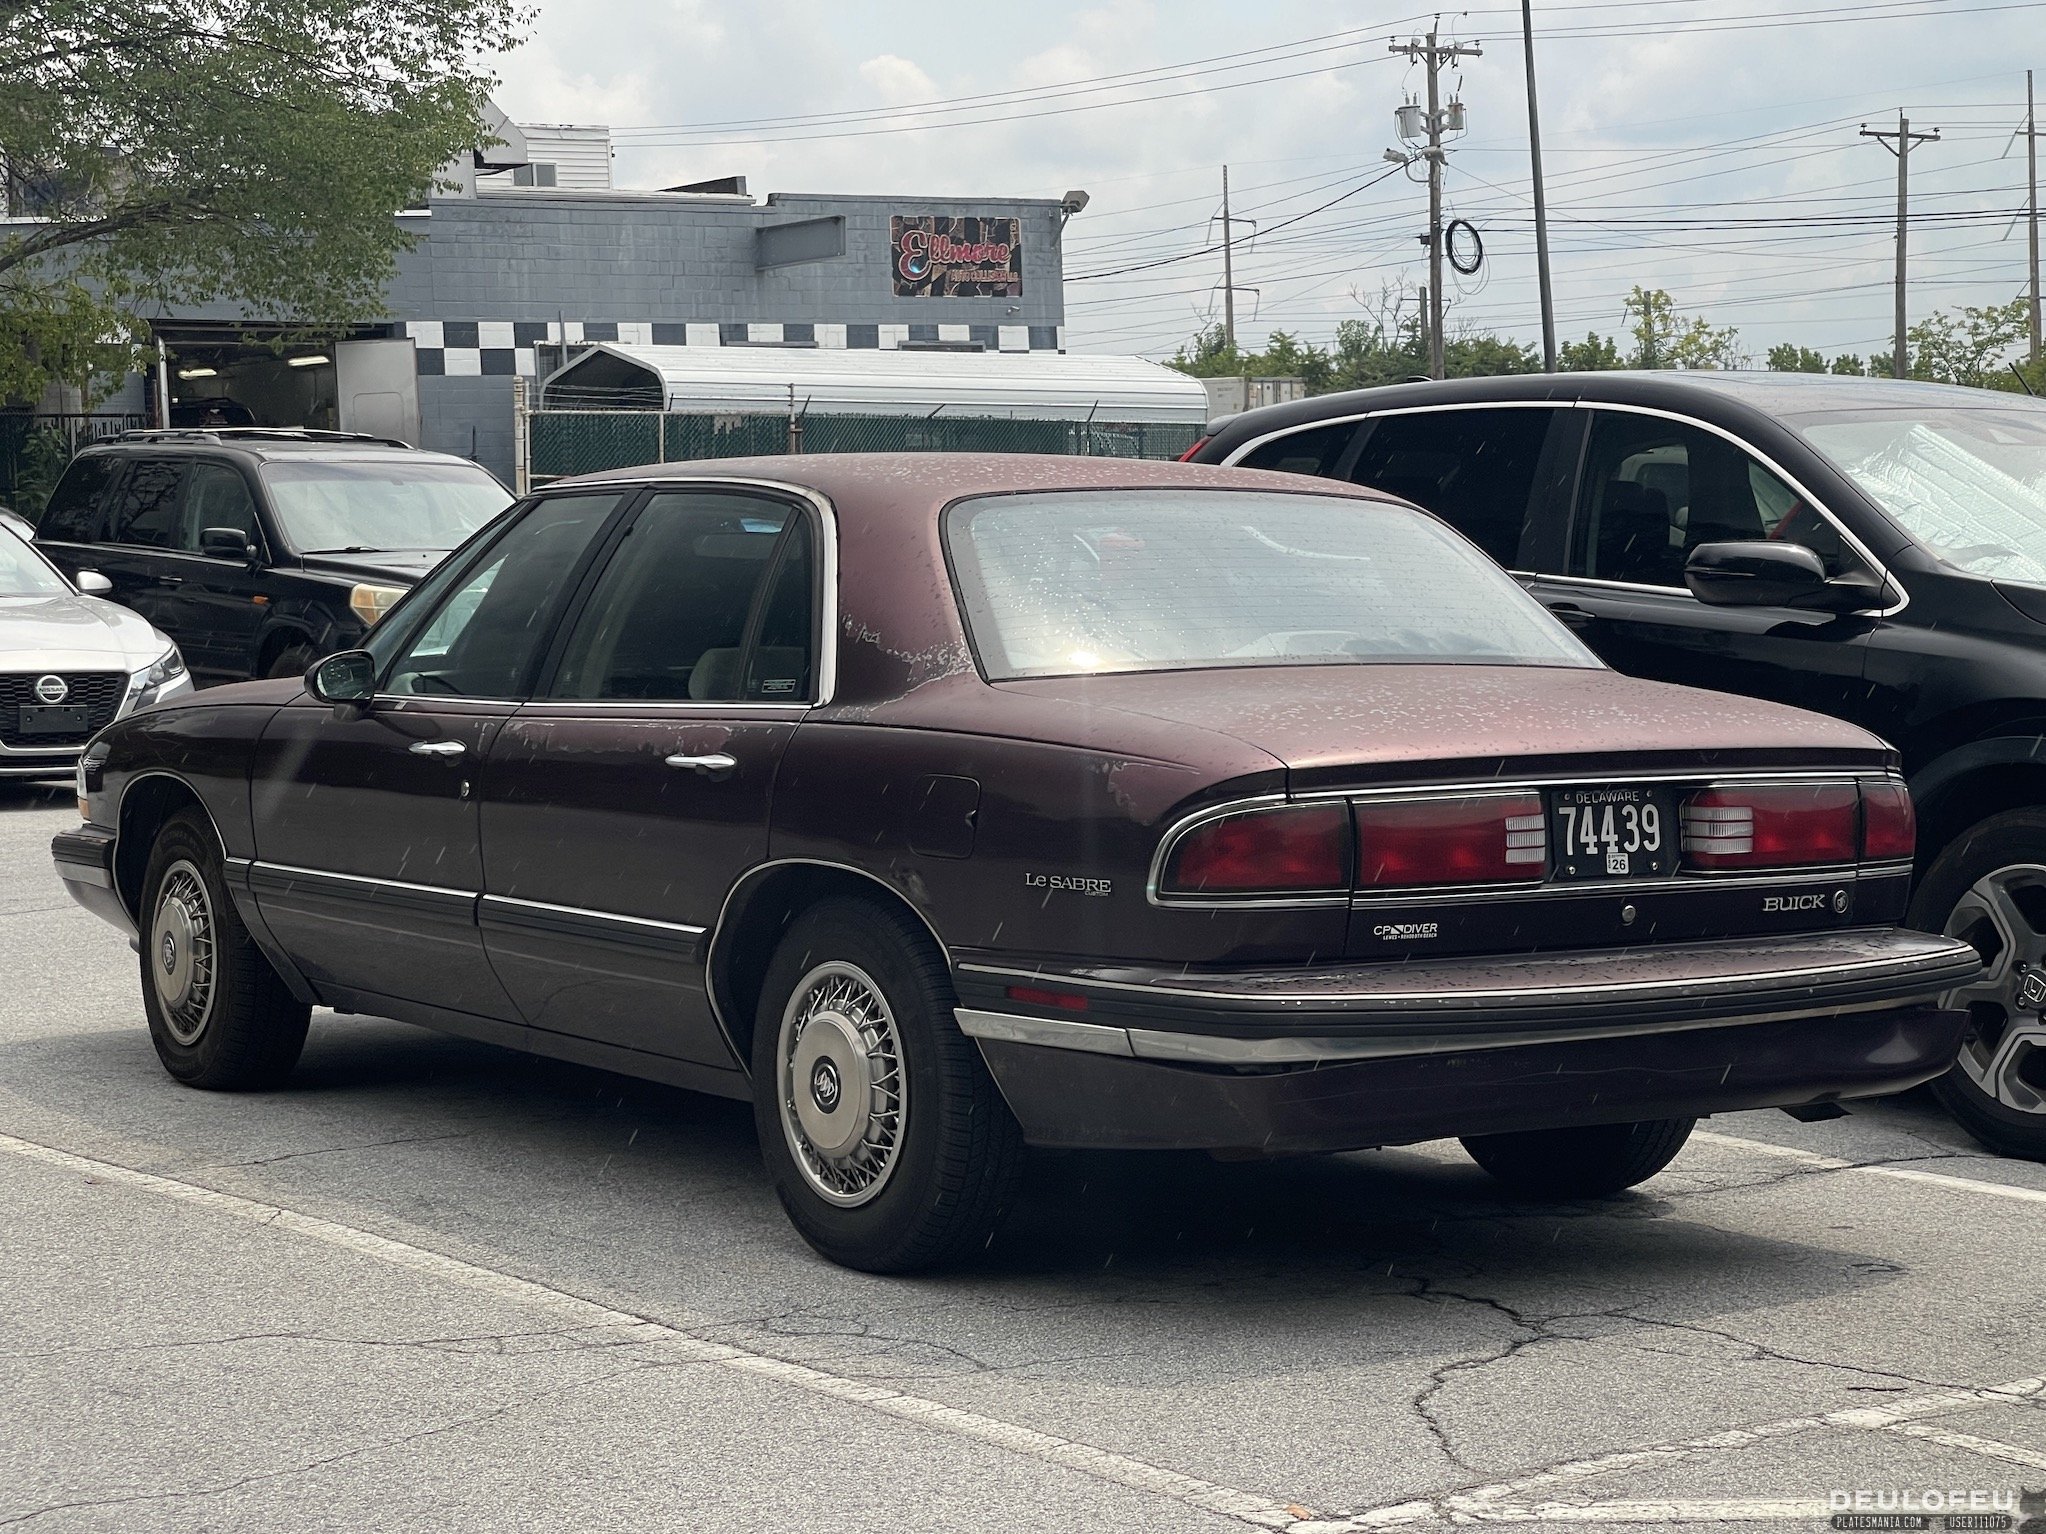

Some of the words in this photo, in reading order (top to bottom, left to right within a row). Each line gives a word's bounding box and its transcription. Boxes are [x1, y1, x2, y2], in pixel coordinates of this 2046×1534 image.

[899, 229, 1011, 280] Ellmore
[1576, 791, 1640, 804] DELAWARE
[1559, 804, 1660, 856] 74439
[1612, 859, 1626, 870] 26
[1049, 875, 1112, 893] SABRE
[1762, 894, 1826, 912] BUICK
[1403, 923, 1438, 934] DIVER
